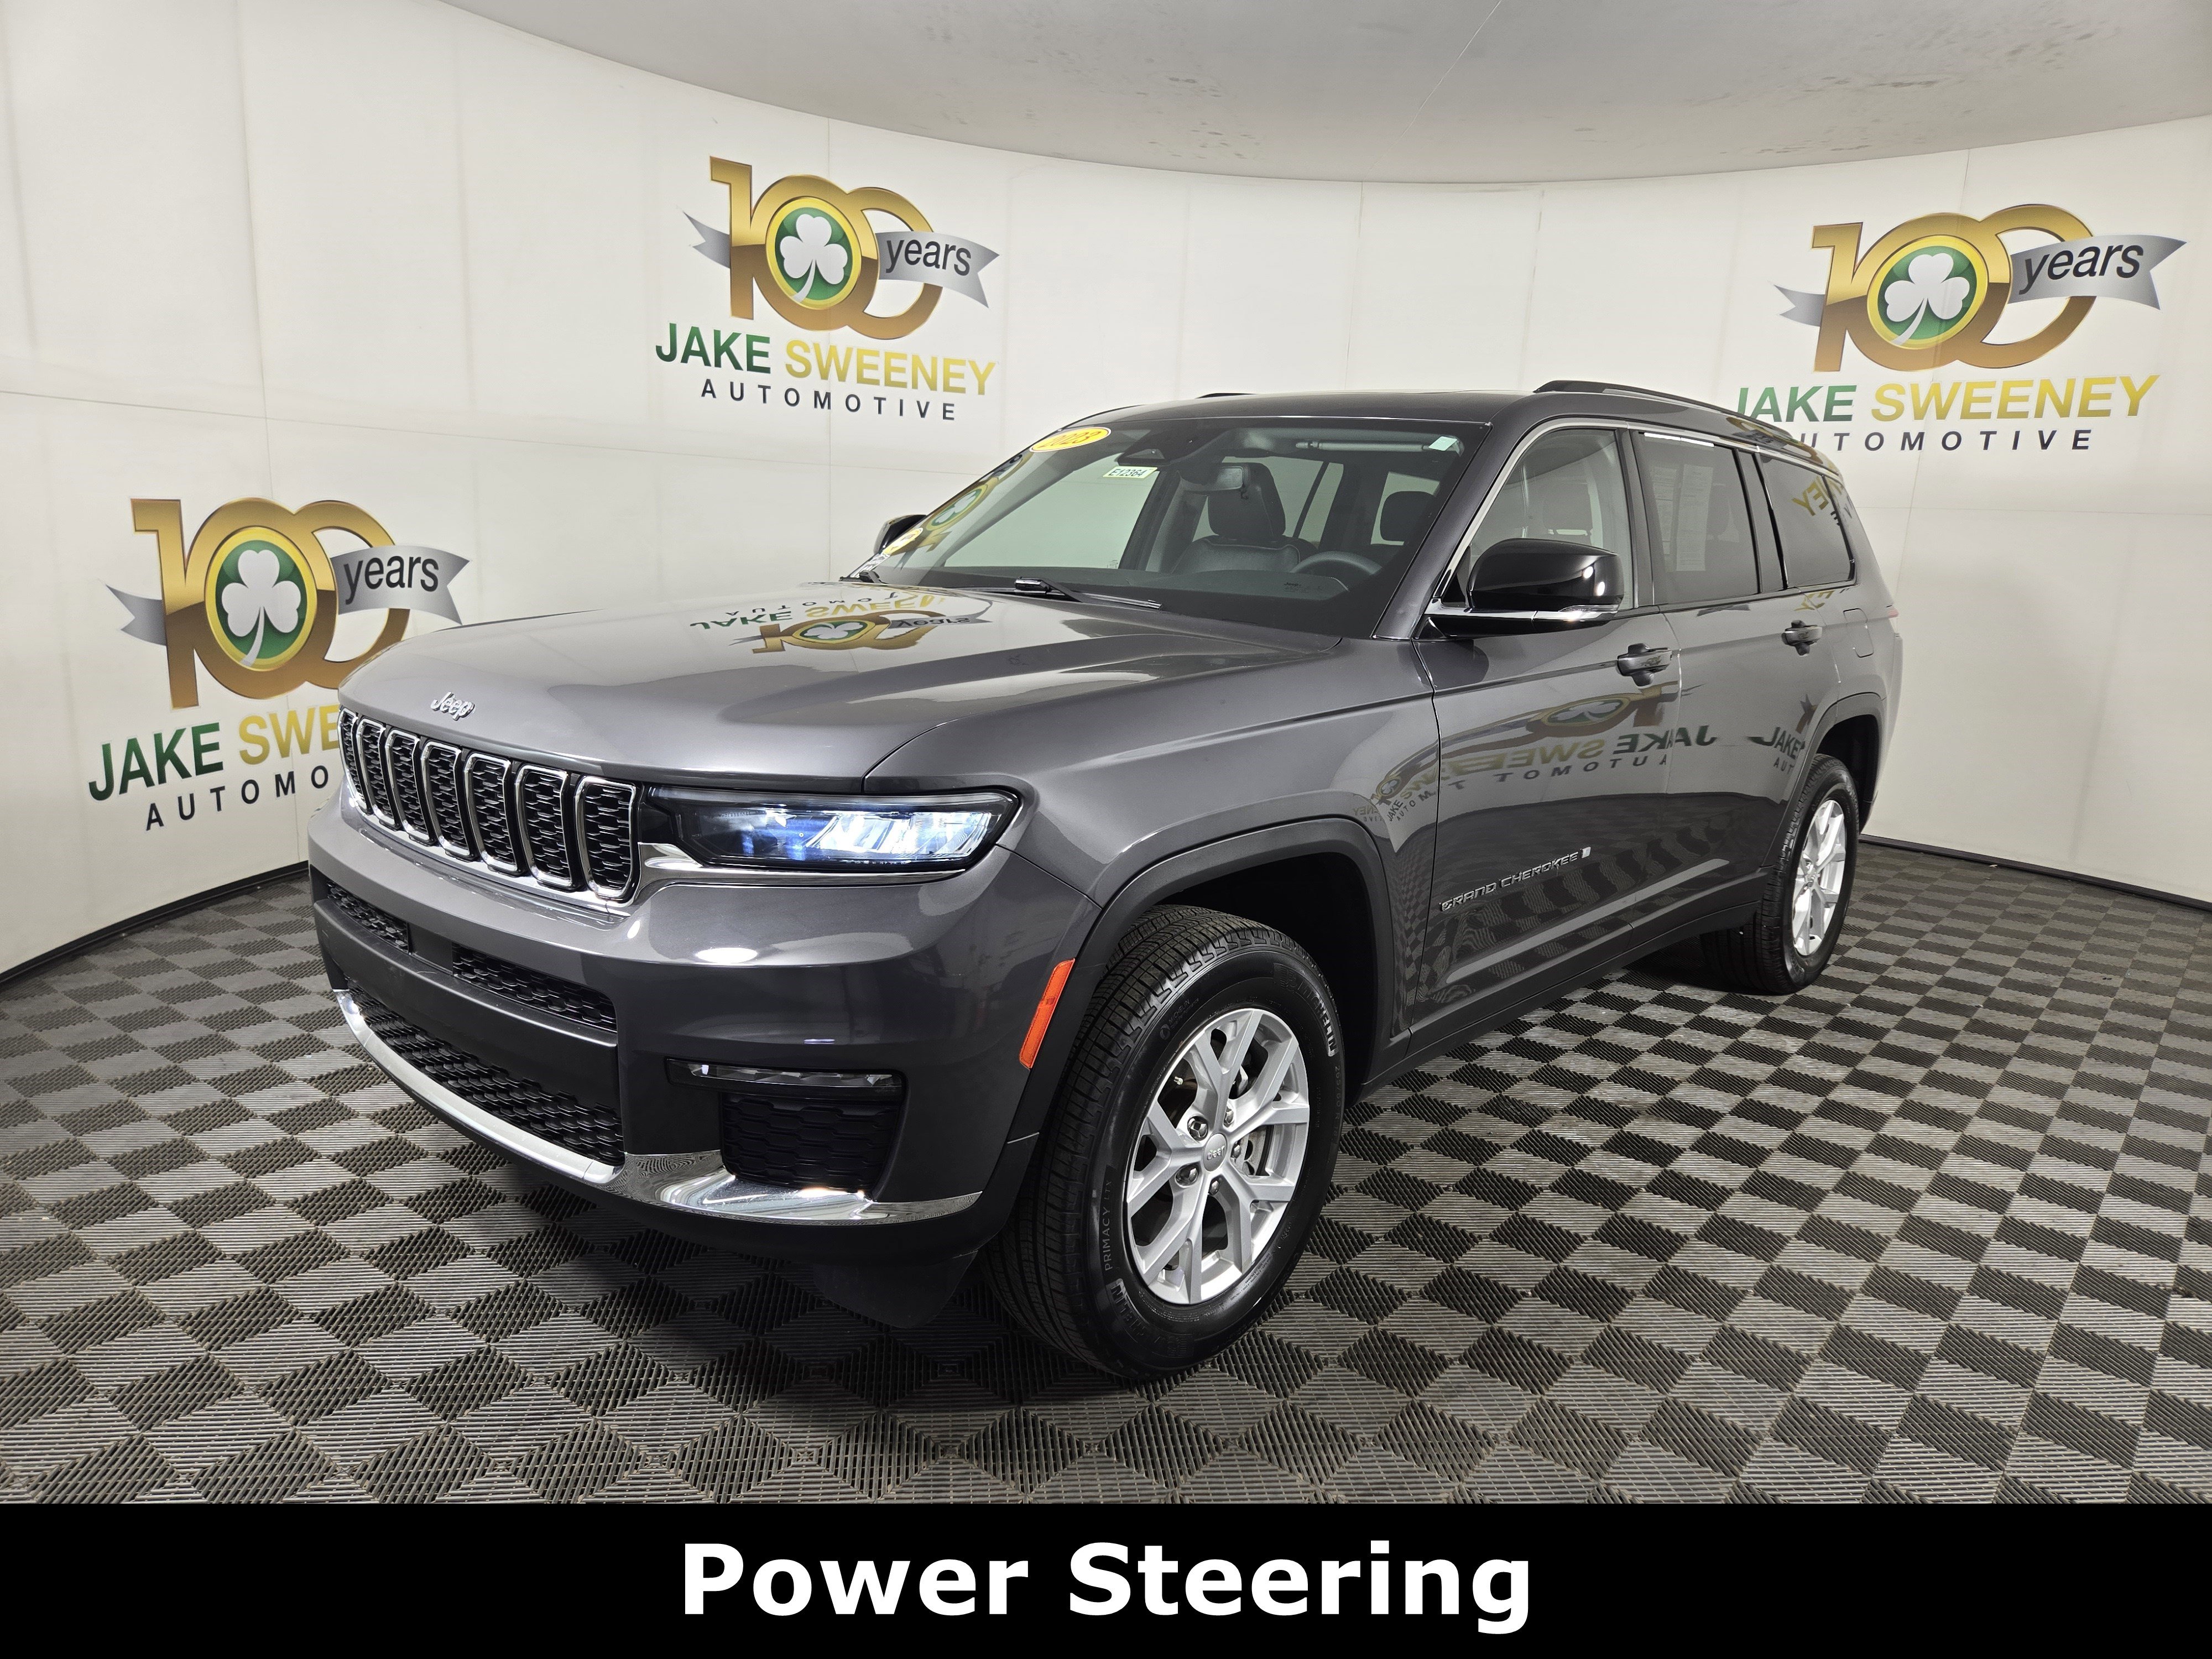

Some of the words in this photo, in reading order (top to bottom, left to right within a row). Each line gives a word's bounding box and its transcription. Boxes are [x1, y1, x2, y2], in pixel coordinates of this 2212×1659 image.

[886, 239, 972, 276] years
[2019, 244, 2143, 295] years
[655, 322, 771, 374] JAKE
[785, 340, 996, 395] SWEENEY
[701, 379, 955, 421] AUTOMOTIVE
[1871, 374, 2160, 421] SWEENEY
[1801, 429, 2092, 452] UTOMOTIVE
[1108, 468, 1147, 477] E12364
[343, 556, 440, 604] years
[431, 691, 475, 721] Jeep
[88, 722, 223, 801] JAKE
[147, 765, 329, 831] AUTOMO
[1441, 882, 1496, 911] GRAND
[1500, 852, 1579, 888] CHEROKEE
[1102, 1207, 1113, 1271] PRIMACY
